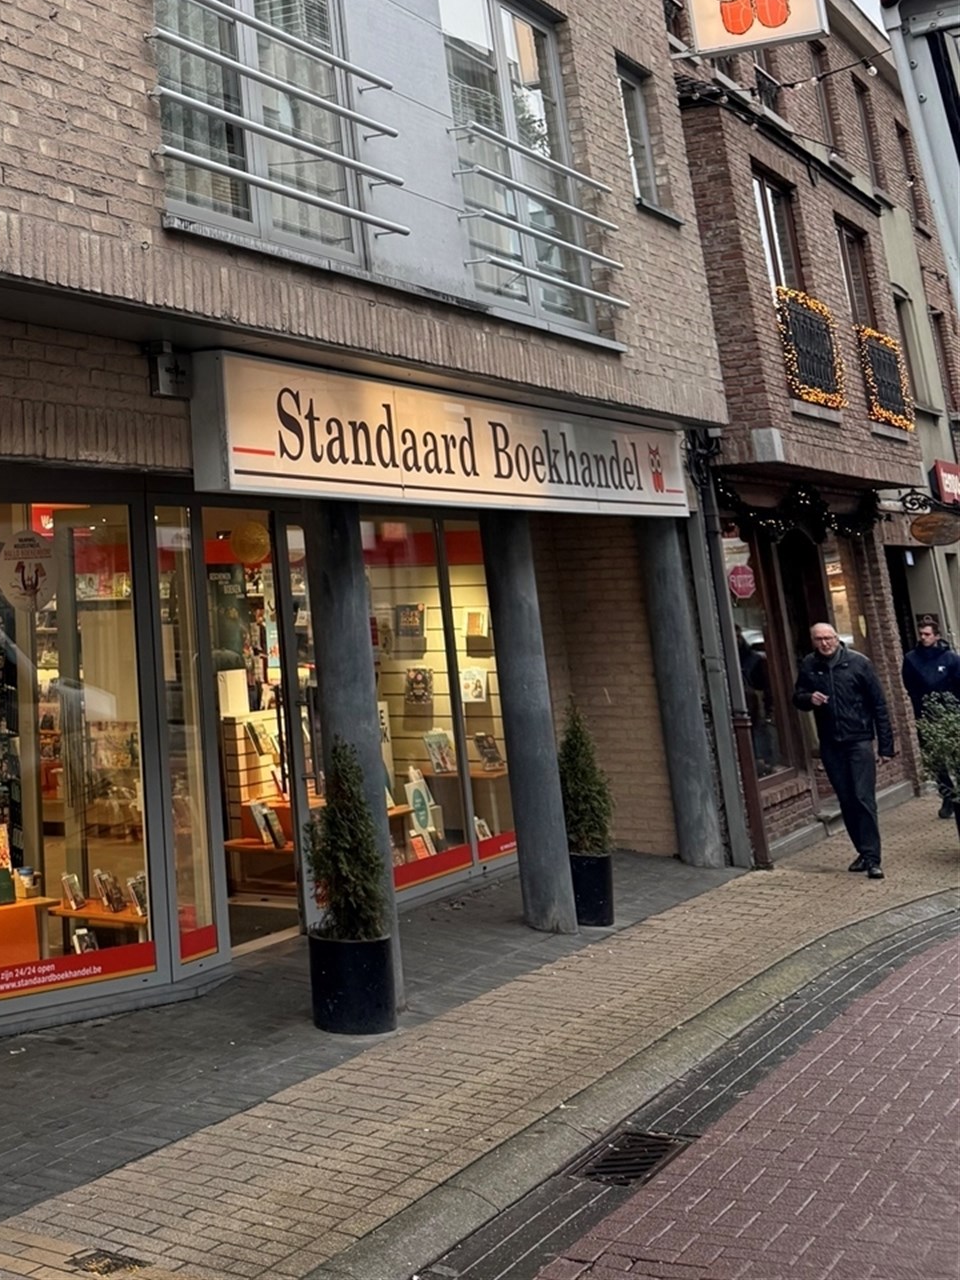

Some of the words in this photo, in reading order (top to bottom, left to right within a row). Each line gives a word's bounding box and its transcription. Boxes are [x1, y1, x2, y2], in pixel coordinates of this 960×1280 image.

[275, 387, 479, 477] Standaard
[487, 420, 643, 491] Boekhandel
[0, 964, 102, 991] www.standaardboekhandel.be
[1, 970, 13, 982] zijn
[15, 965, 36, 978] 24/24
[37, 962, 55, 974] open
